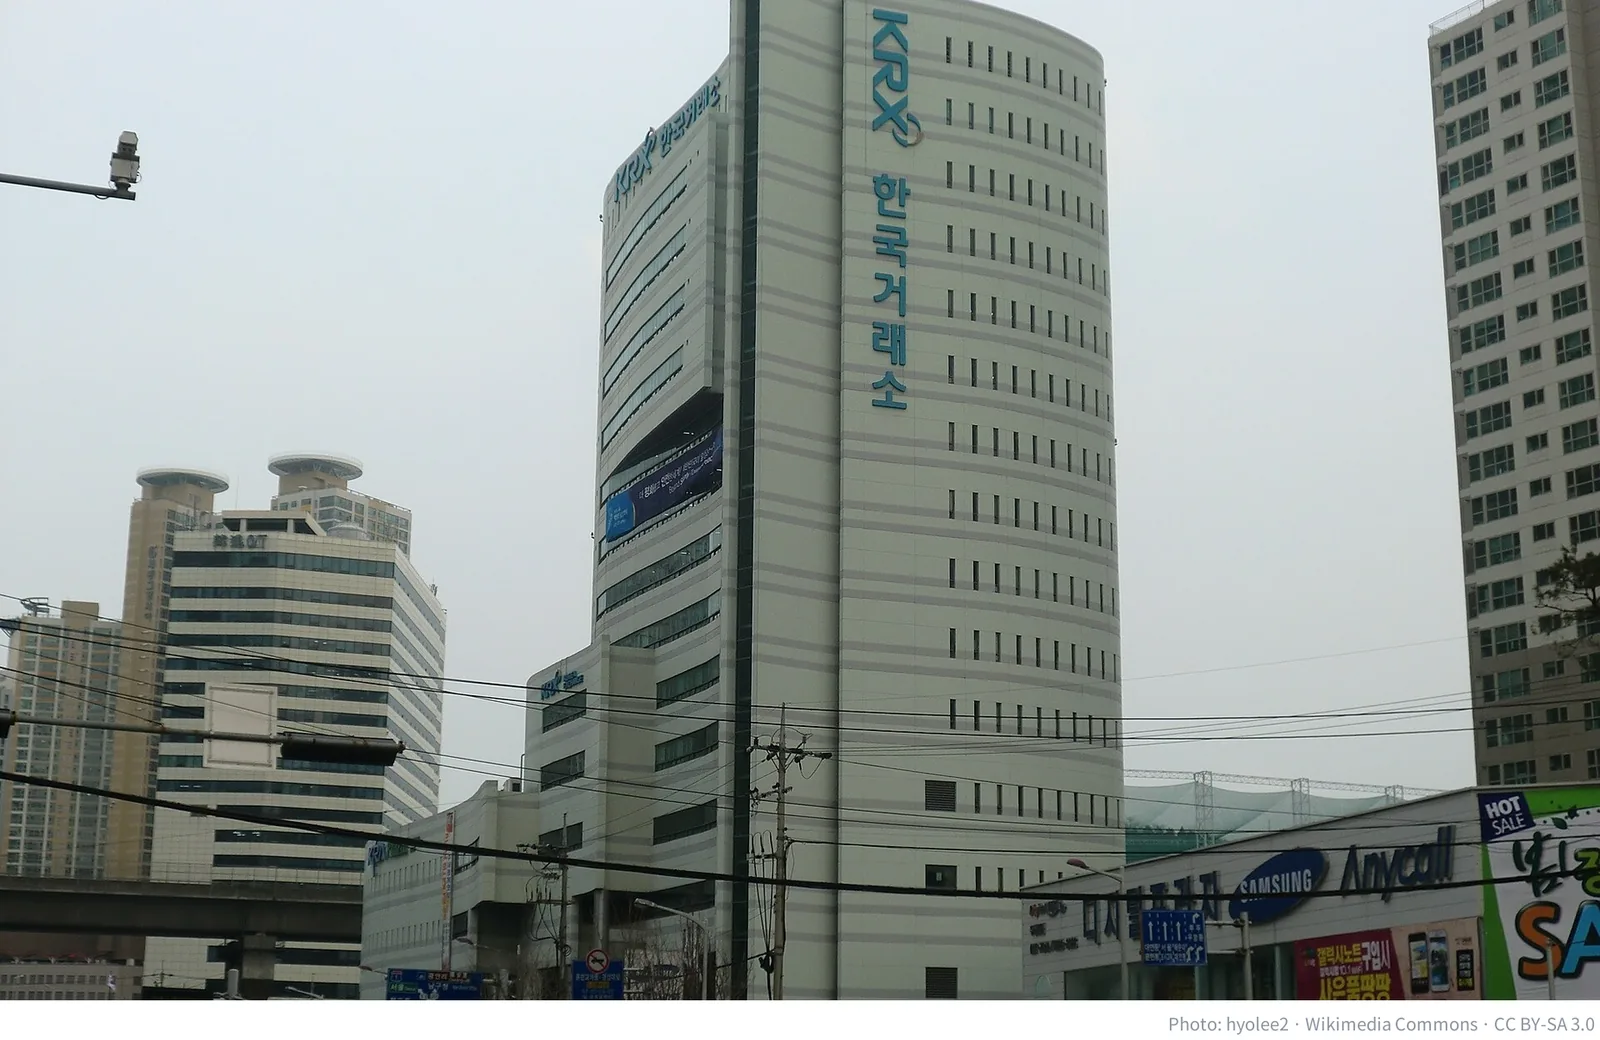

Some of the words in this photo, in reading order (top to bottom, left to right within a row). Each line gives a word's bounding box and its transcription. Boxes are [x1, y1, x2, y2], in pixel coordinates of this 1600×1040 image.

[872, 8, 910, 132] KRX
[660, 76, 721, 158] 한국거래소
[614, 137, 653, 203] KRX
[872, 173, 911, 410] 한국거래소
[1485, 796, 1522, 819] HOT
[1492, 812, 1527, 835] SALE
[1240, 869, 1312, 904] SAMSUNG
[1339, 824, 1457, 904] Anycall
[1317, 944, 1362, 966] 갤럭시노트
[1362, 940, 1391, 971] 구입시
